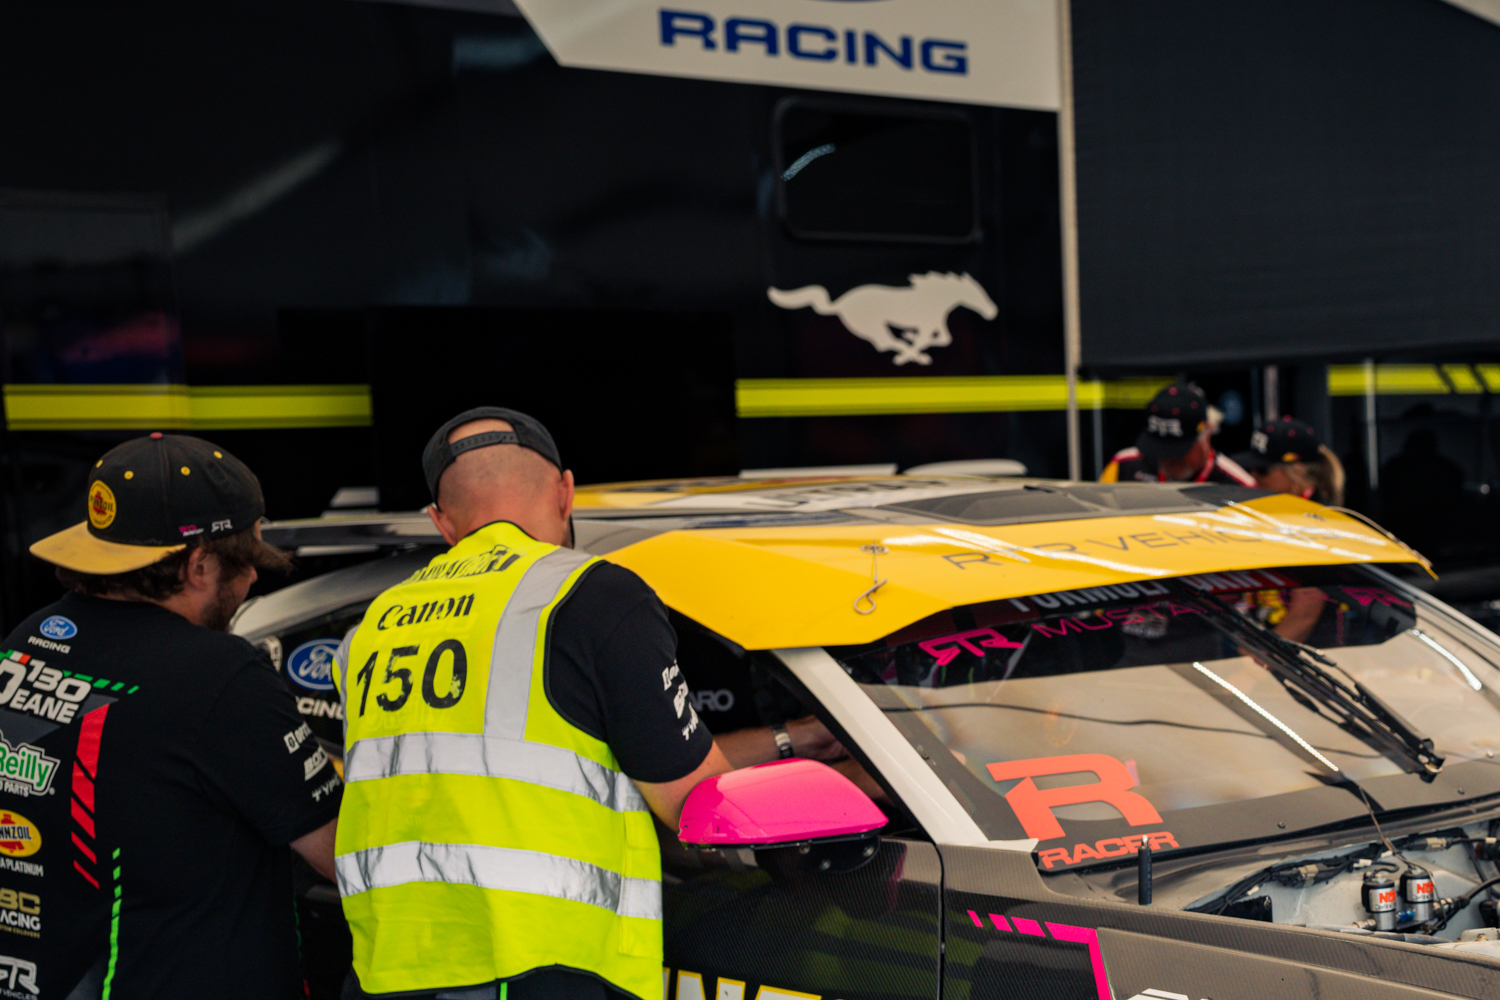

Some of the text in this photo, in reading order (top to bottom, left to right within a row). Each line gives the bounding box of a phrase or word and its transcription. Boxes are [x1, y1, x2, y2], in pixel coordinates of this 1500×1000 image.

[658, 8, 969, 76] RACING
[43, 617, 70, 637] Ford
[376, 592, 476, 631] Canon
[27, 635, 71, 655] RACING
[918, 626, 1024, 666] RTR
[26, 658, 92, 703] 130
[356, 638, 468, 718] 150
[4, 781, 30, 798] PARTS
[985, 752, 1164, 841] R
[1038, 831, 1181, 870] RACER
[0, 908, 41, 932] ACING
